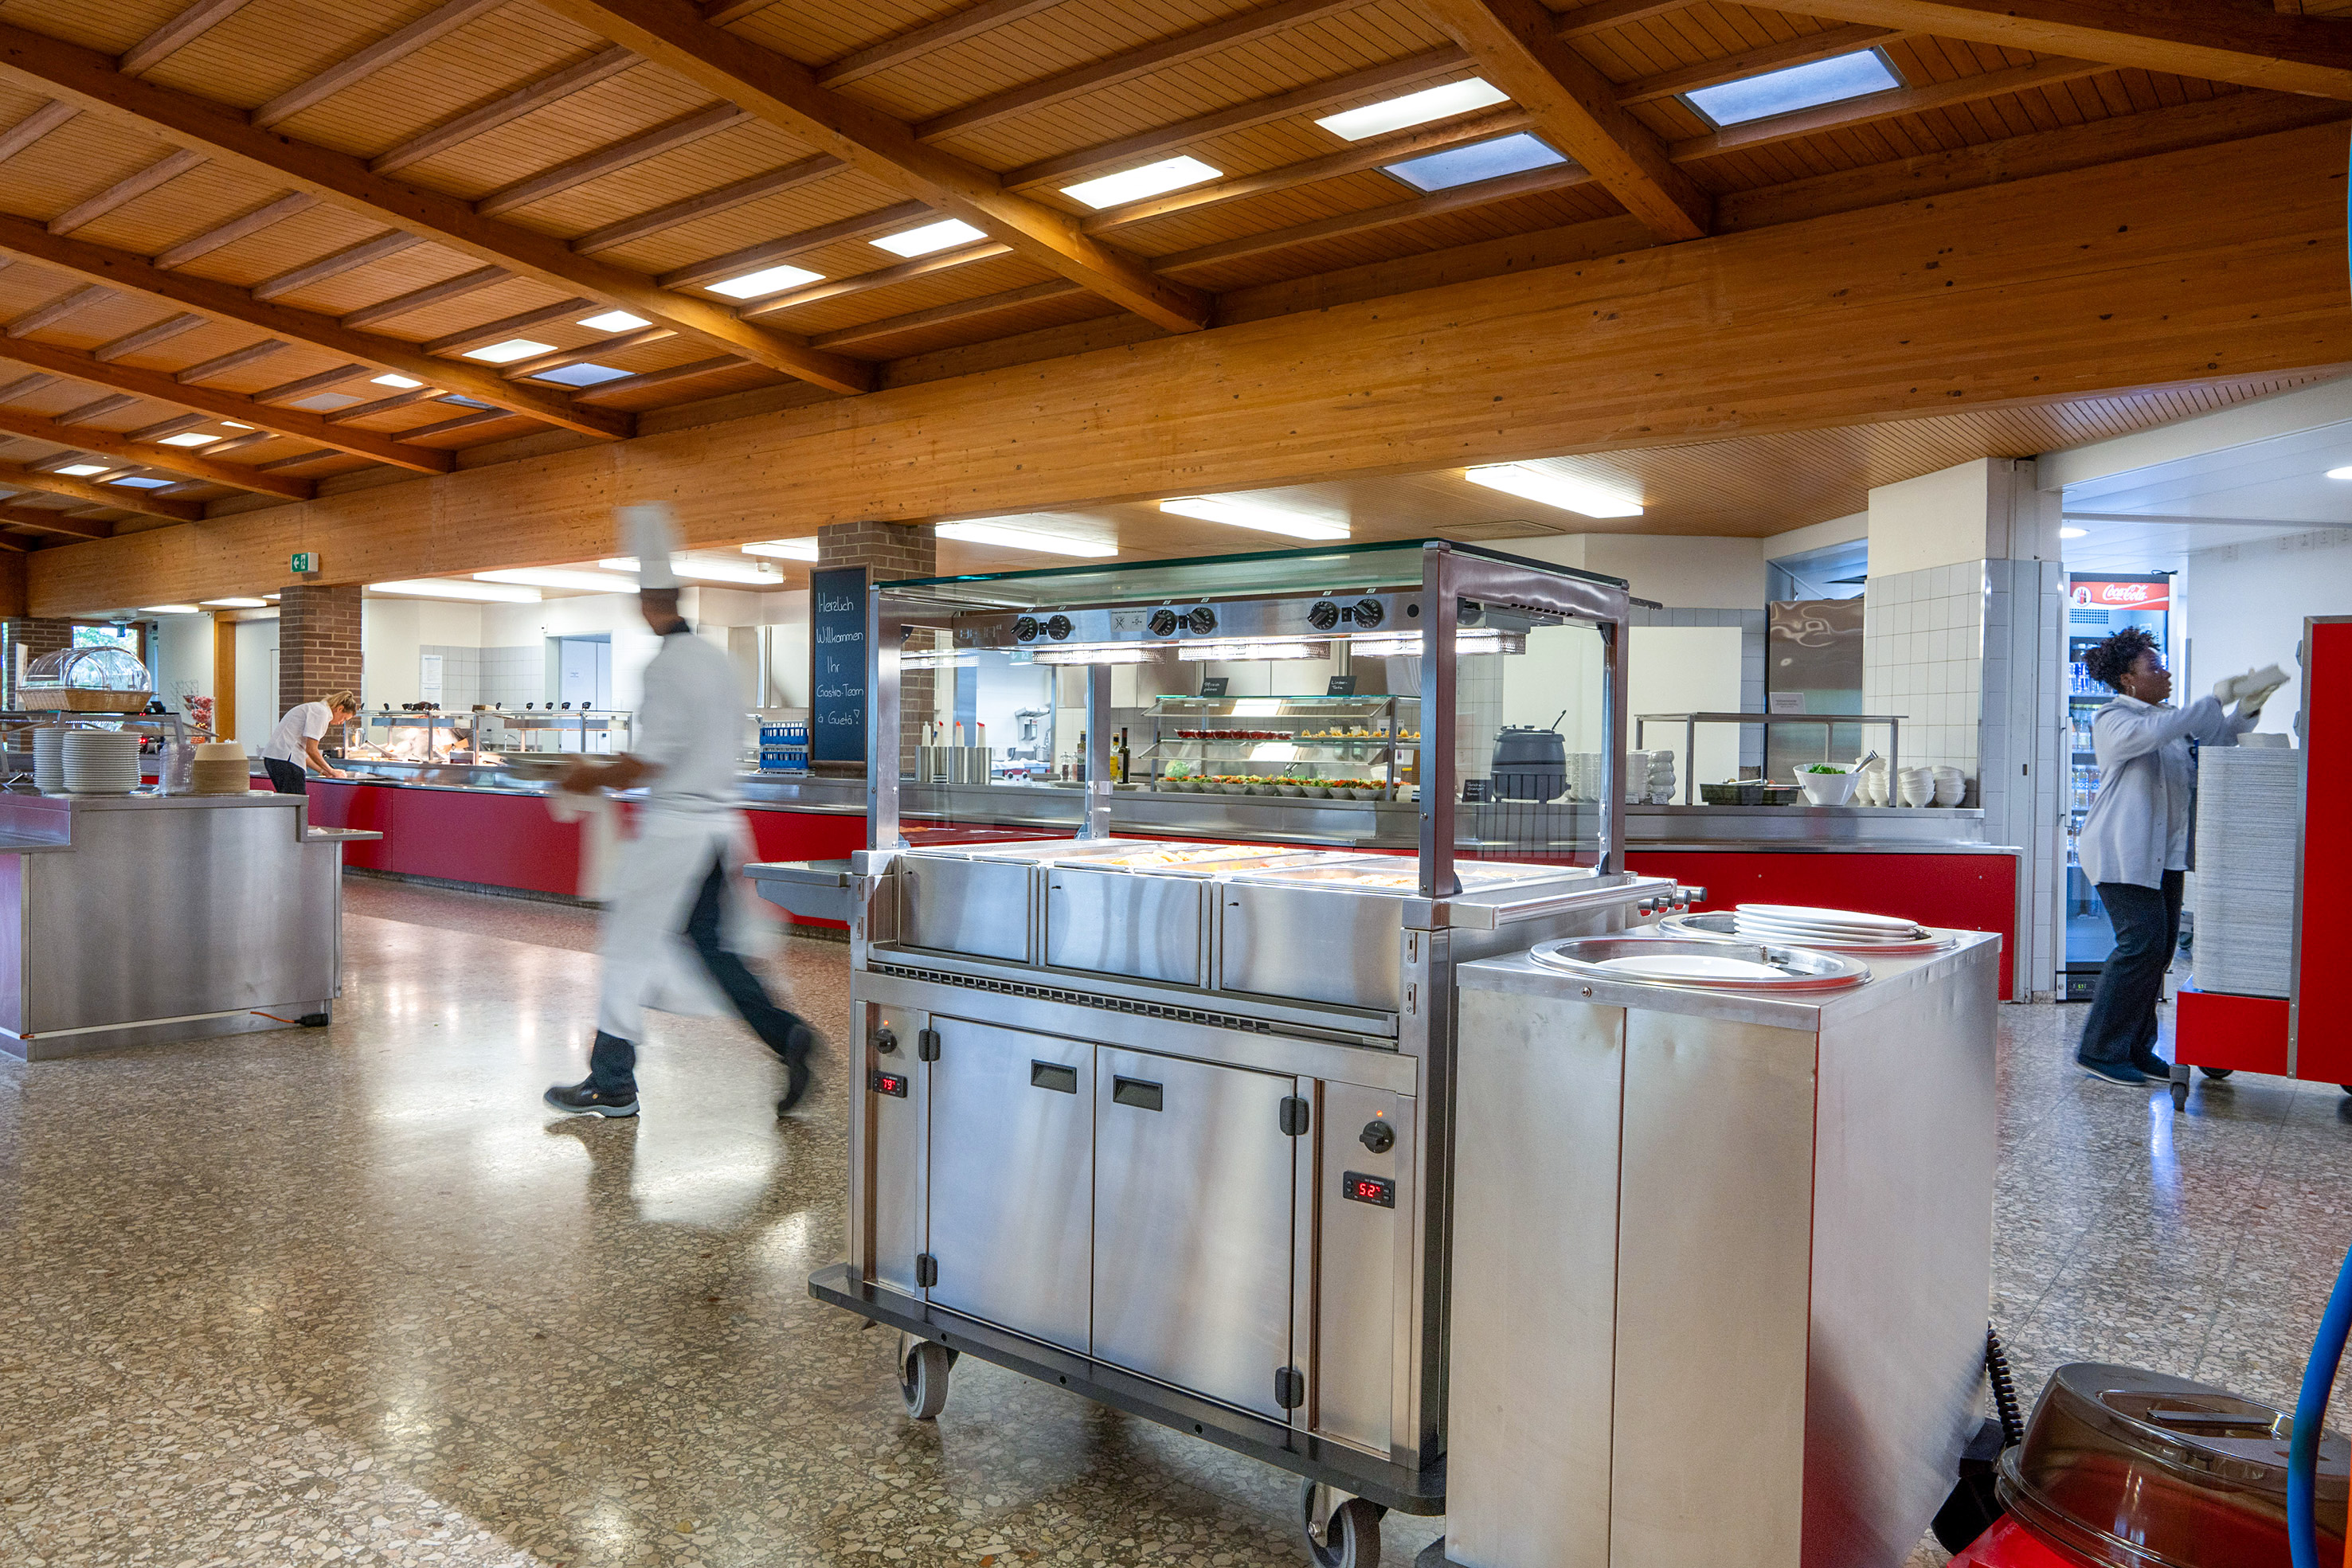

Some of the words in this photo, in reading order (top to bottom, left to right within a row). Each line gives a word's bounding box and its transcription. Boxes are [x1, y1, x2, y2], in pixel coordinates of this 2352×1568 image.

[2103, 584, 2149, 601] Coca-Cola
[818, 592, 854, 612] Herzlich
[816, 626, 863, 643] Willkommen
[827, 655, 840, 673] Ihr
[816, 683, 864, 698] Gastro-Team
